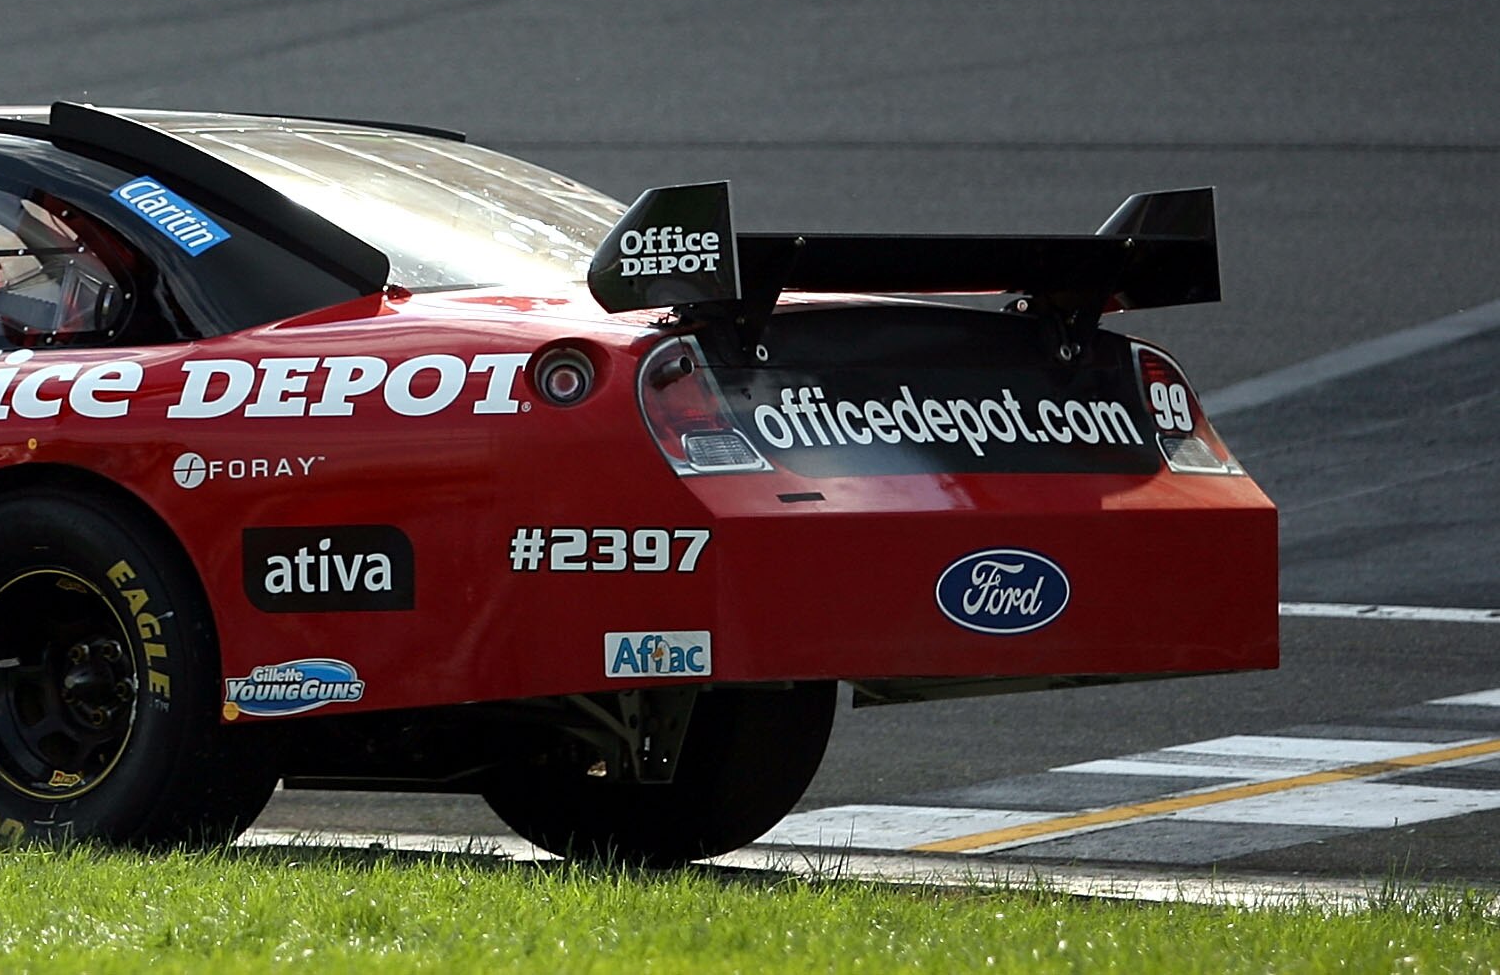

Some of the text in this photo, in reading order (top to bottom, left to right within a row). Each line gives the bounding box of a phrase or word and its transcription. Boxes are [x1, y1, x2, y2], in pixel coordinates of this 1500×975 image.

[117, 180, 213, 253] Claritin
[620, 227, 719, 255] Office
[621, 253, 719, 276] DEPOT
[167, 353, 532, 419] DEPOT
[1148, 382, 1196, 432] 99
[754, 387, 1144, 456] officedepot.com
[209, 456, 316, 479] FORAY
[265, 538, 392, 594] ativa
[510, 528, 711, 573] #2397
[962, 560, 1046, 616] Ford
[106, 560, 171, 700] EAGLE
[612, 635, 705, 673] Aflac
[252, 668, 304, 682] Gillette
